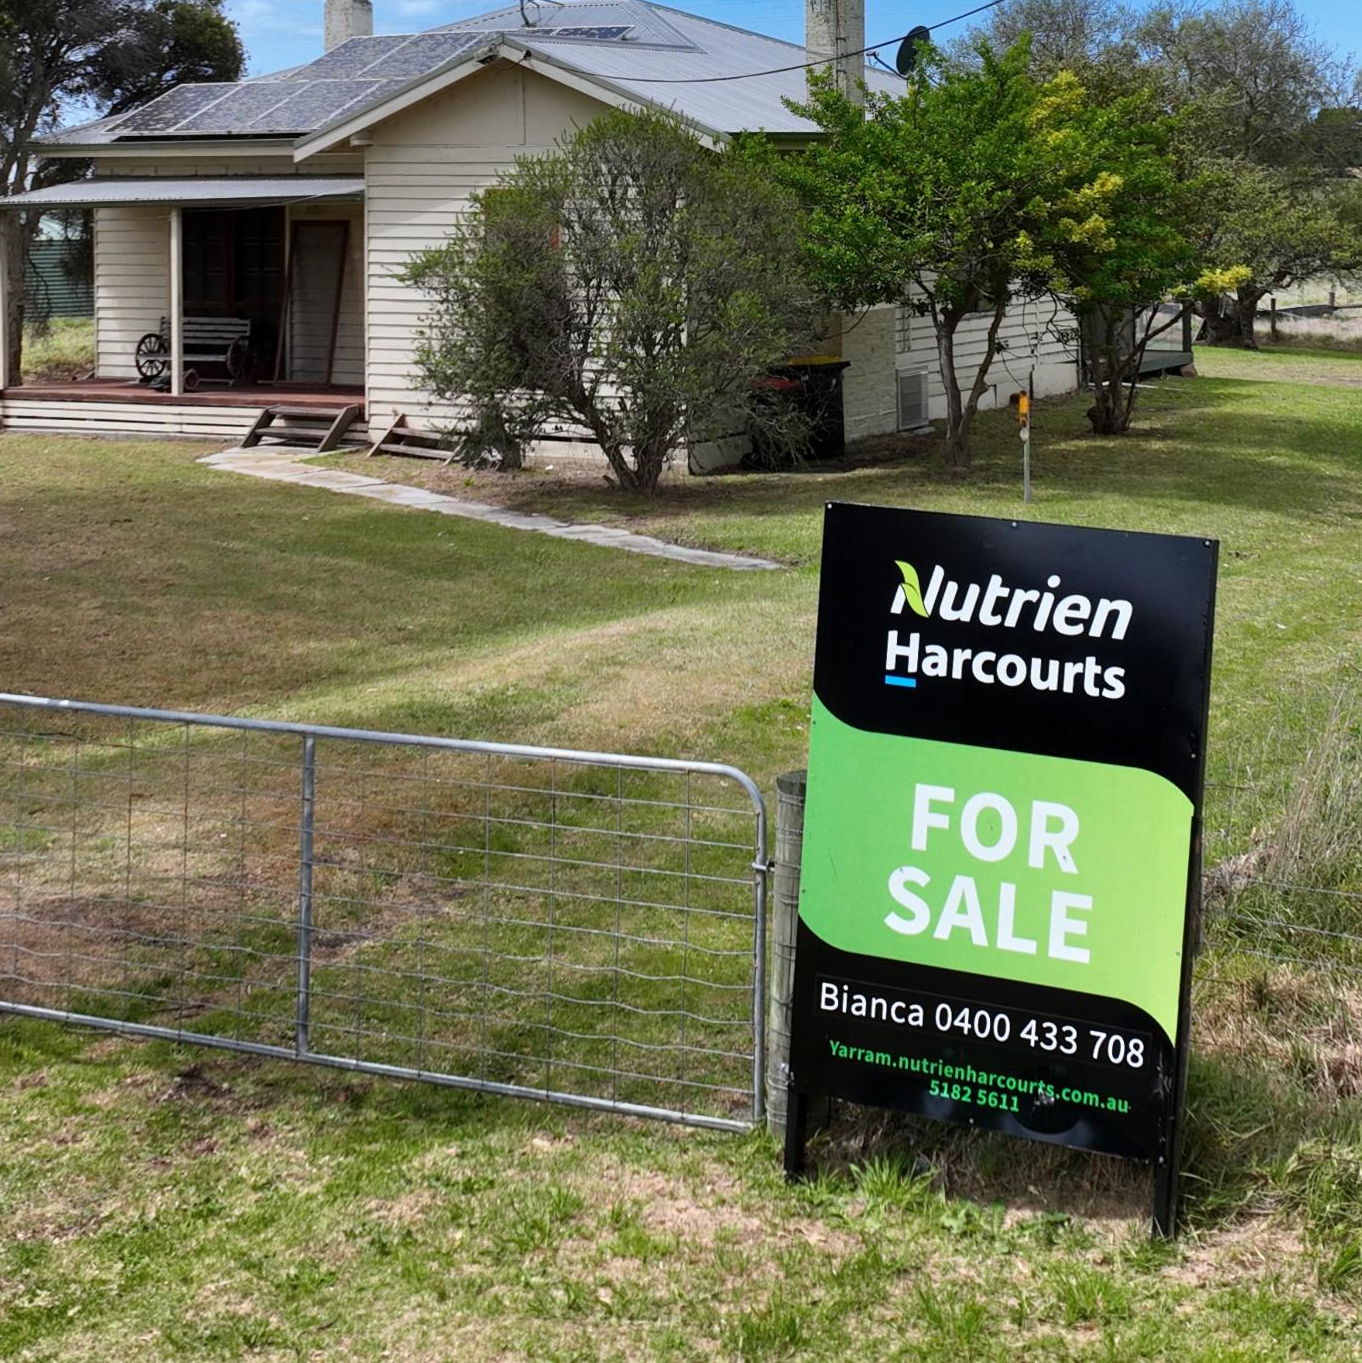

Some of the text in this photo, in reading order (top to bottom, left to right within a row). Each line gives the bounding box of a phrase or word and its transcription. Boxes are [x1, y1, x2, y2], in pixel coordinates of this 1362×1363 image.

[890, 560, 1133, 640] Nutrien
[885, 630, 1126, 699] Harcourts
[911, 783, 1080, 874] FOR
[884, 866, 1093, 964] SALE
[820, 982, 1145, 1069] Bianca 0400 433 708
[829, 1040, 1129, 1114] Yarram.nutrienharcourts.com.au
[929, 1080, 1020, 1113] 5182 5611
